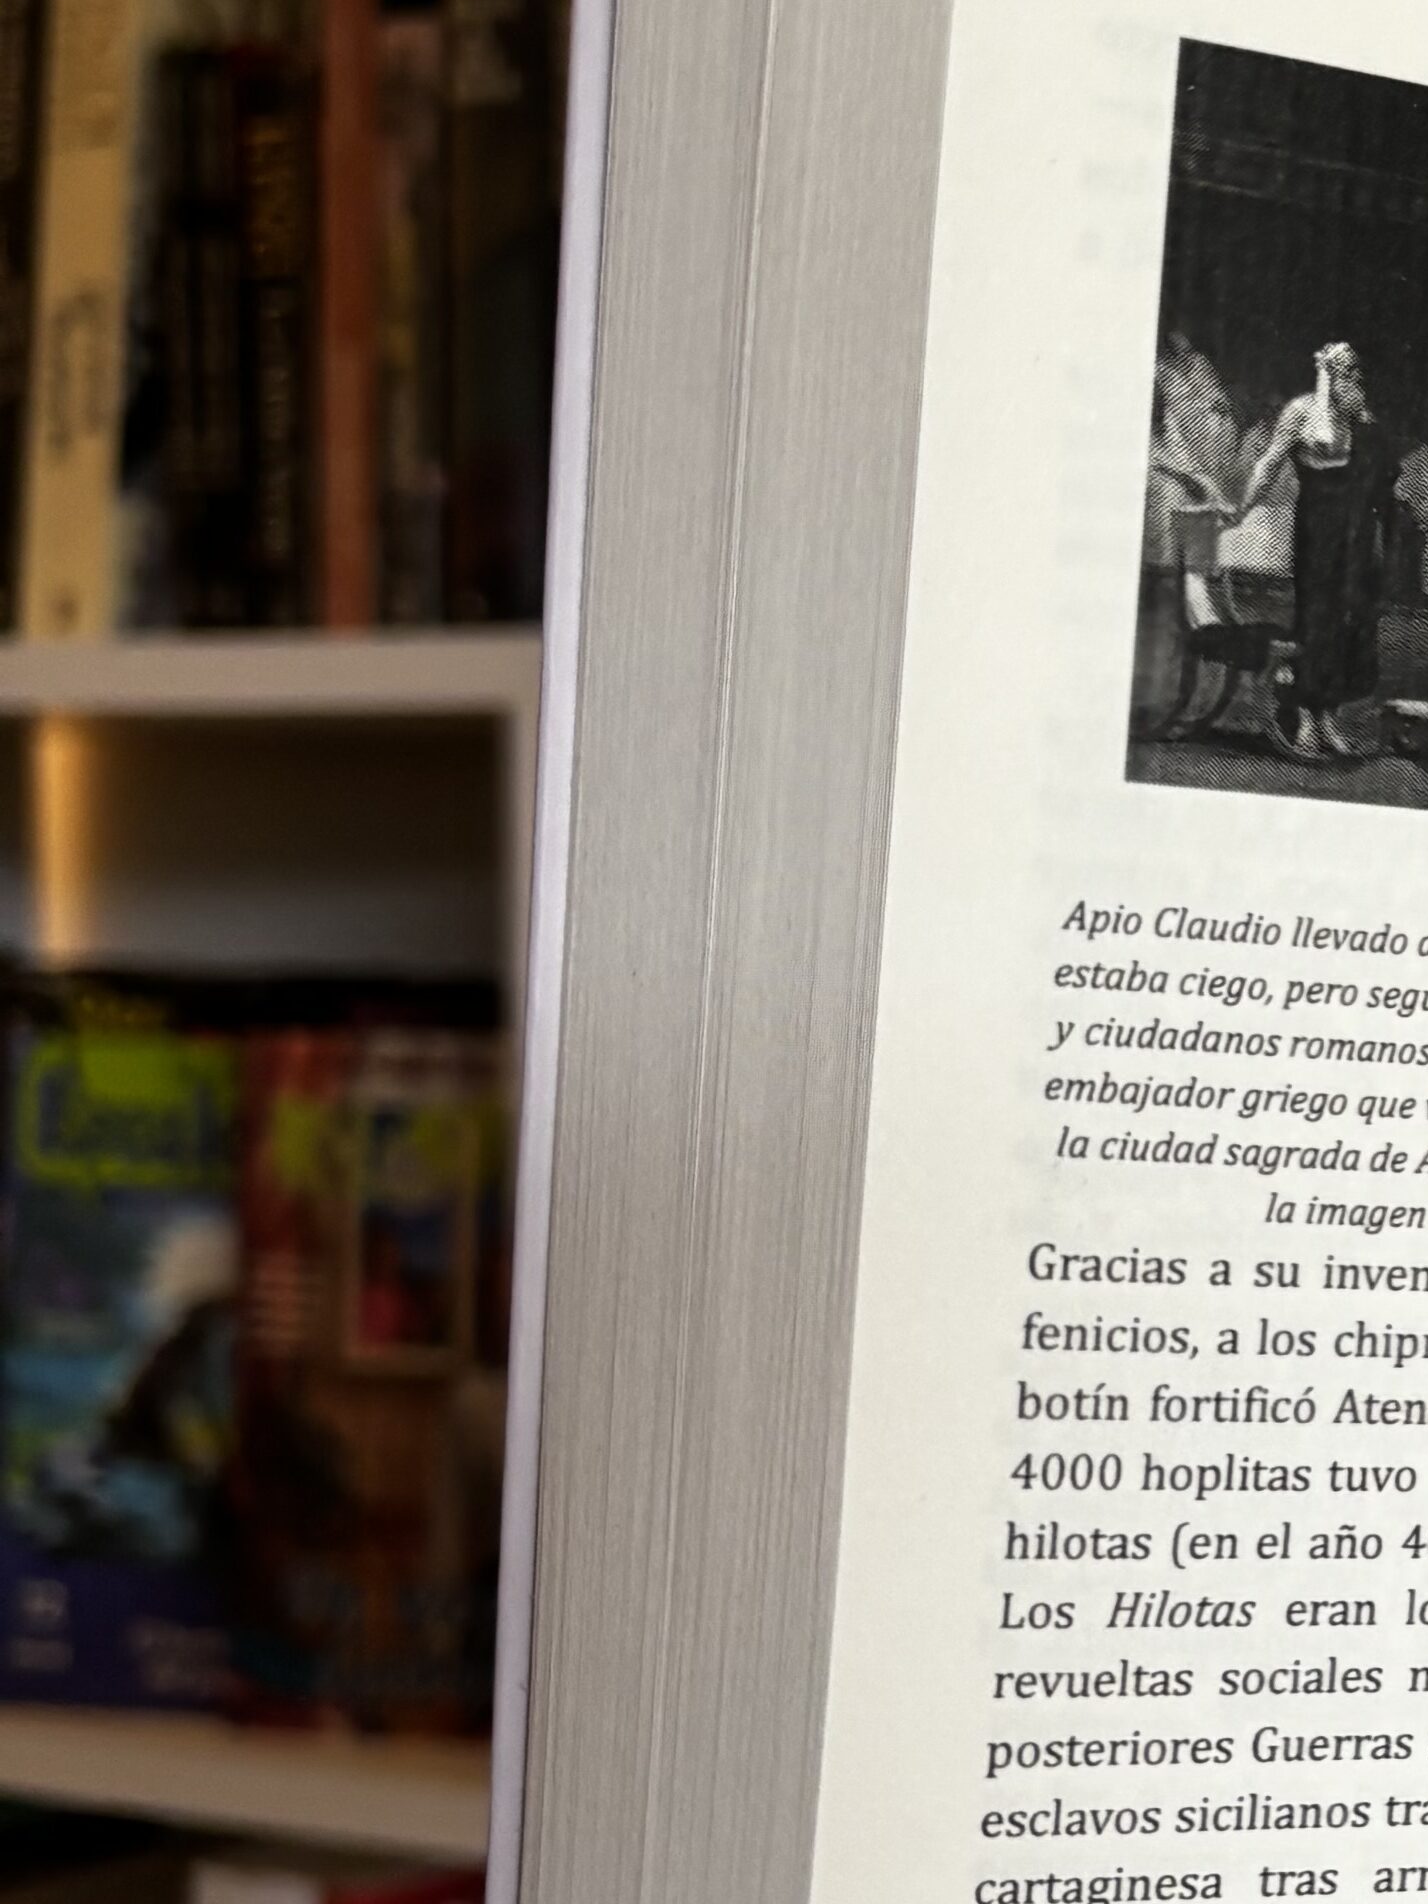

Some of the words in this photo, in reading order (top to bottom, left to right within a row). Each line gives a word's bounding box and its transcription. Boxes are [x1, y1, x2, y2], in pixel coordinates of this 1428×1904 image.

[1061, 900, 1143, 941] Apio
[1154, 906, 1282, 946] Claudio
[1291, 916, 1409, 956] llevado
[1265, 1191, 1297, 1224] la
[1305, 1195, 1427, 1235] imagen
[1028, 1242, 1188, 1285] Gracias
[1208, 1259, 1232, 1287] a
[1253, 1261, 1300, 1288] su
[1010, 1452, 1123, 1491] 4000
[1140, 1452, 1312, 1502] hoplitas
[1328, 1460, 1417, 1493] tuvo
[999, 1592, 1076, 1630] Los
[1106, 1589, 1257, 1629] Hilotas
[1285, 1600, 1377, 1627] eran
[1258, 1866, 1339, 1898] tras
